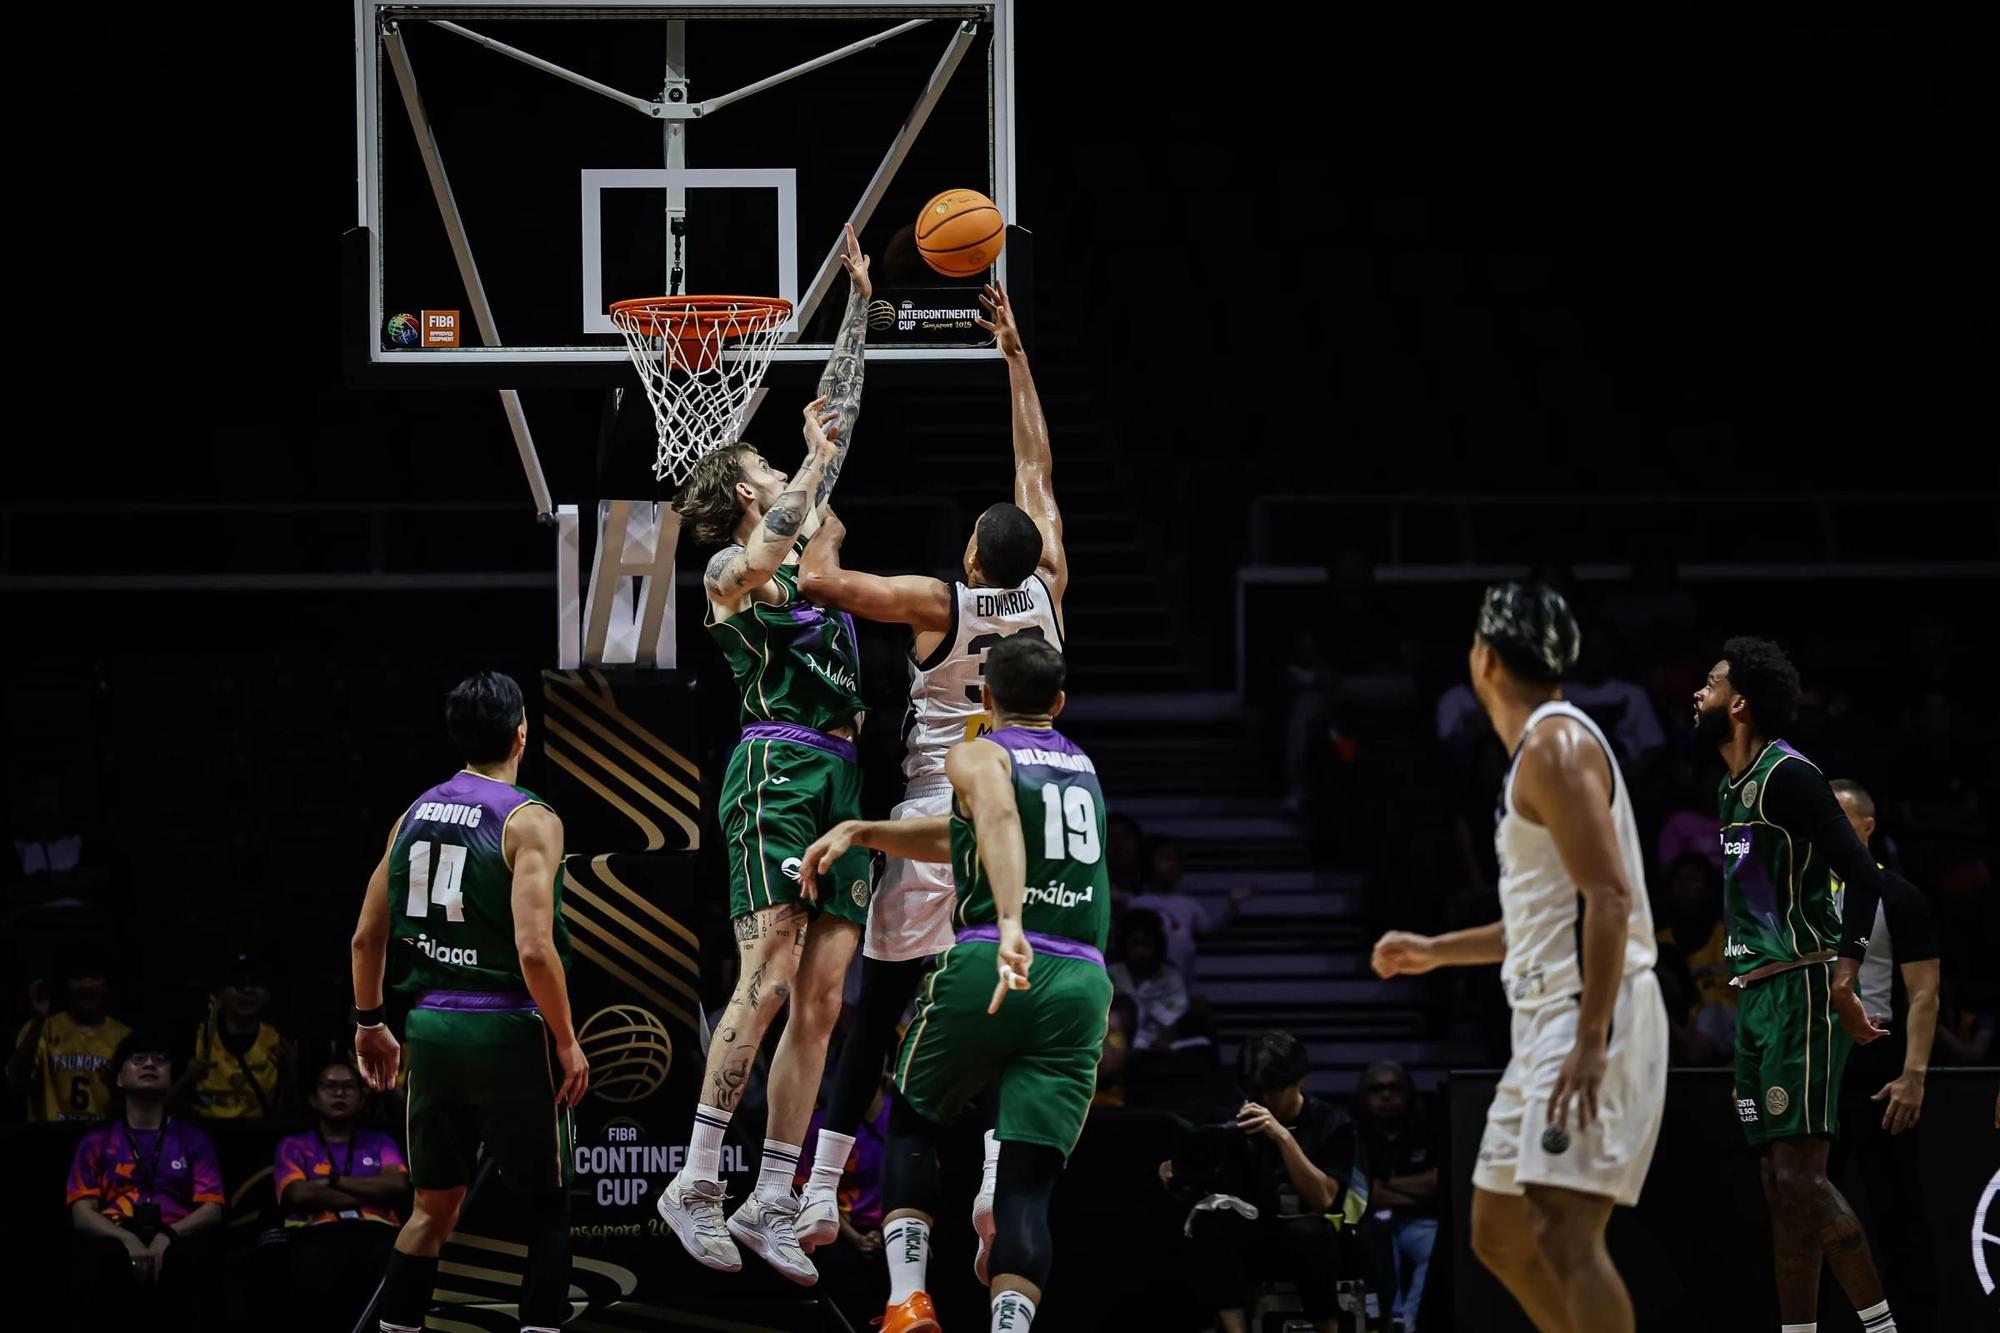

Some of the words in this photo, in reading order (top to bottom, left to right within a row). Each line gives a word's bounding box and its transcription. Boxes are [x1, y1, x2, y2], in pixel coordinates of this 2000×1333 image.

[429, 315, 455, 328] FIBA
[898, 309, 982, 320] INTERCONTINENTAL
[898, 320, 916, 331] CUP
[976, 589, 1035, 618] EDWARDS
[414, 802, 483, 829] DEDOVIĆ
[1041, 782, 1101, 865] 19
[405, 840, 468, 923] 14
[71, 1076, 90, 1109] 6
[608, 1127, 637, 1141] FIBA
[597, 1178, 648, 1206] CUP
[648, 1217, 672, 1237] 20
